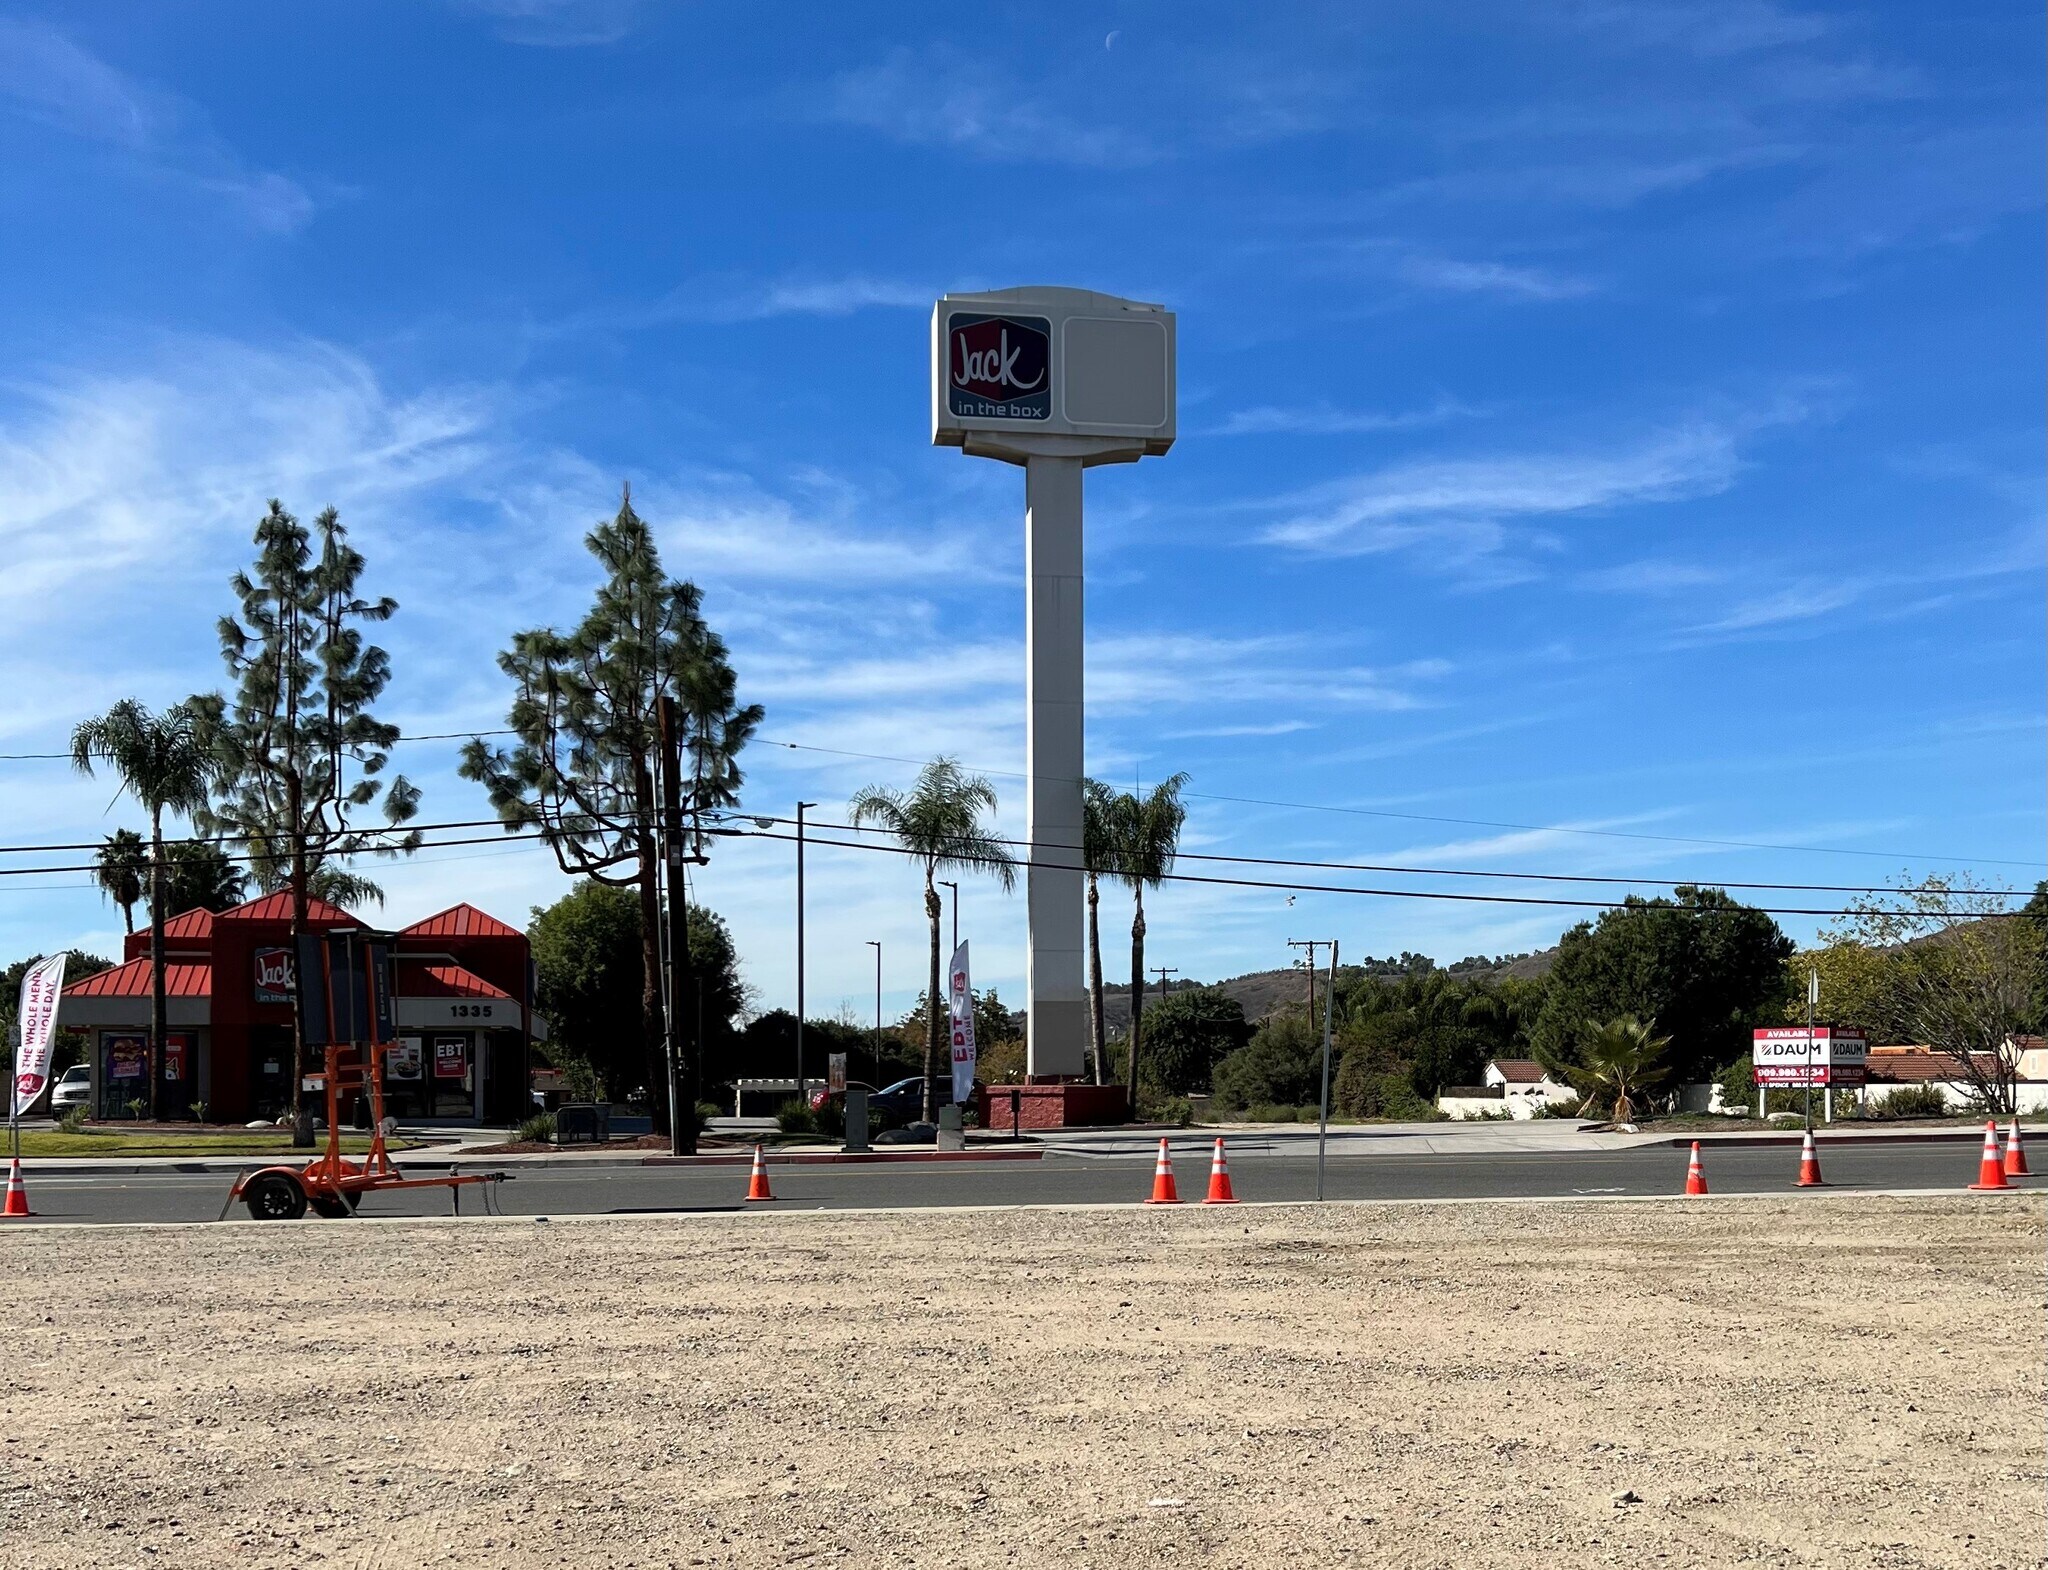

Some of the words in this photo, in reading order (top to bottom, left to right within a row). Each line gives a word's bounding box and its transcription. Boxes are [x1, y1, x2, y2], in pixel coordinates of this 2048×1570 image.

[954, 328, 1044, 389] Jack
[958, 401, 973, 415] in
[978, 402, 1006, 416] the
[1010, 403, 1042, 417] box
[450, 1005, 492, 1017] 1335
[25, 1006, 38, 1045] WHOLE
[1766, 1030, 1815, 1038] AVAILABLE
[953, 1015, 967, 1062] EBT
[964, 1015, 974, 1060] WELCOME
[22, 1047, 33, 1068] THE
[35, 1048, 46, 1068] THE
[437, 1043, 463, 1057] EBT
[1774, 1043, 1821, 1055] DAUM
[1839, 1043, 1863, 1055] DAUM
